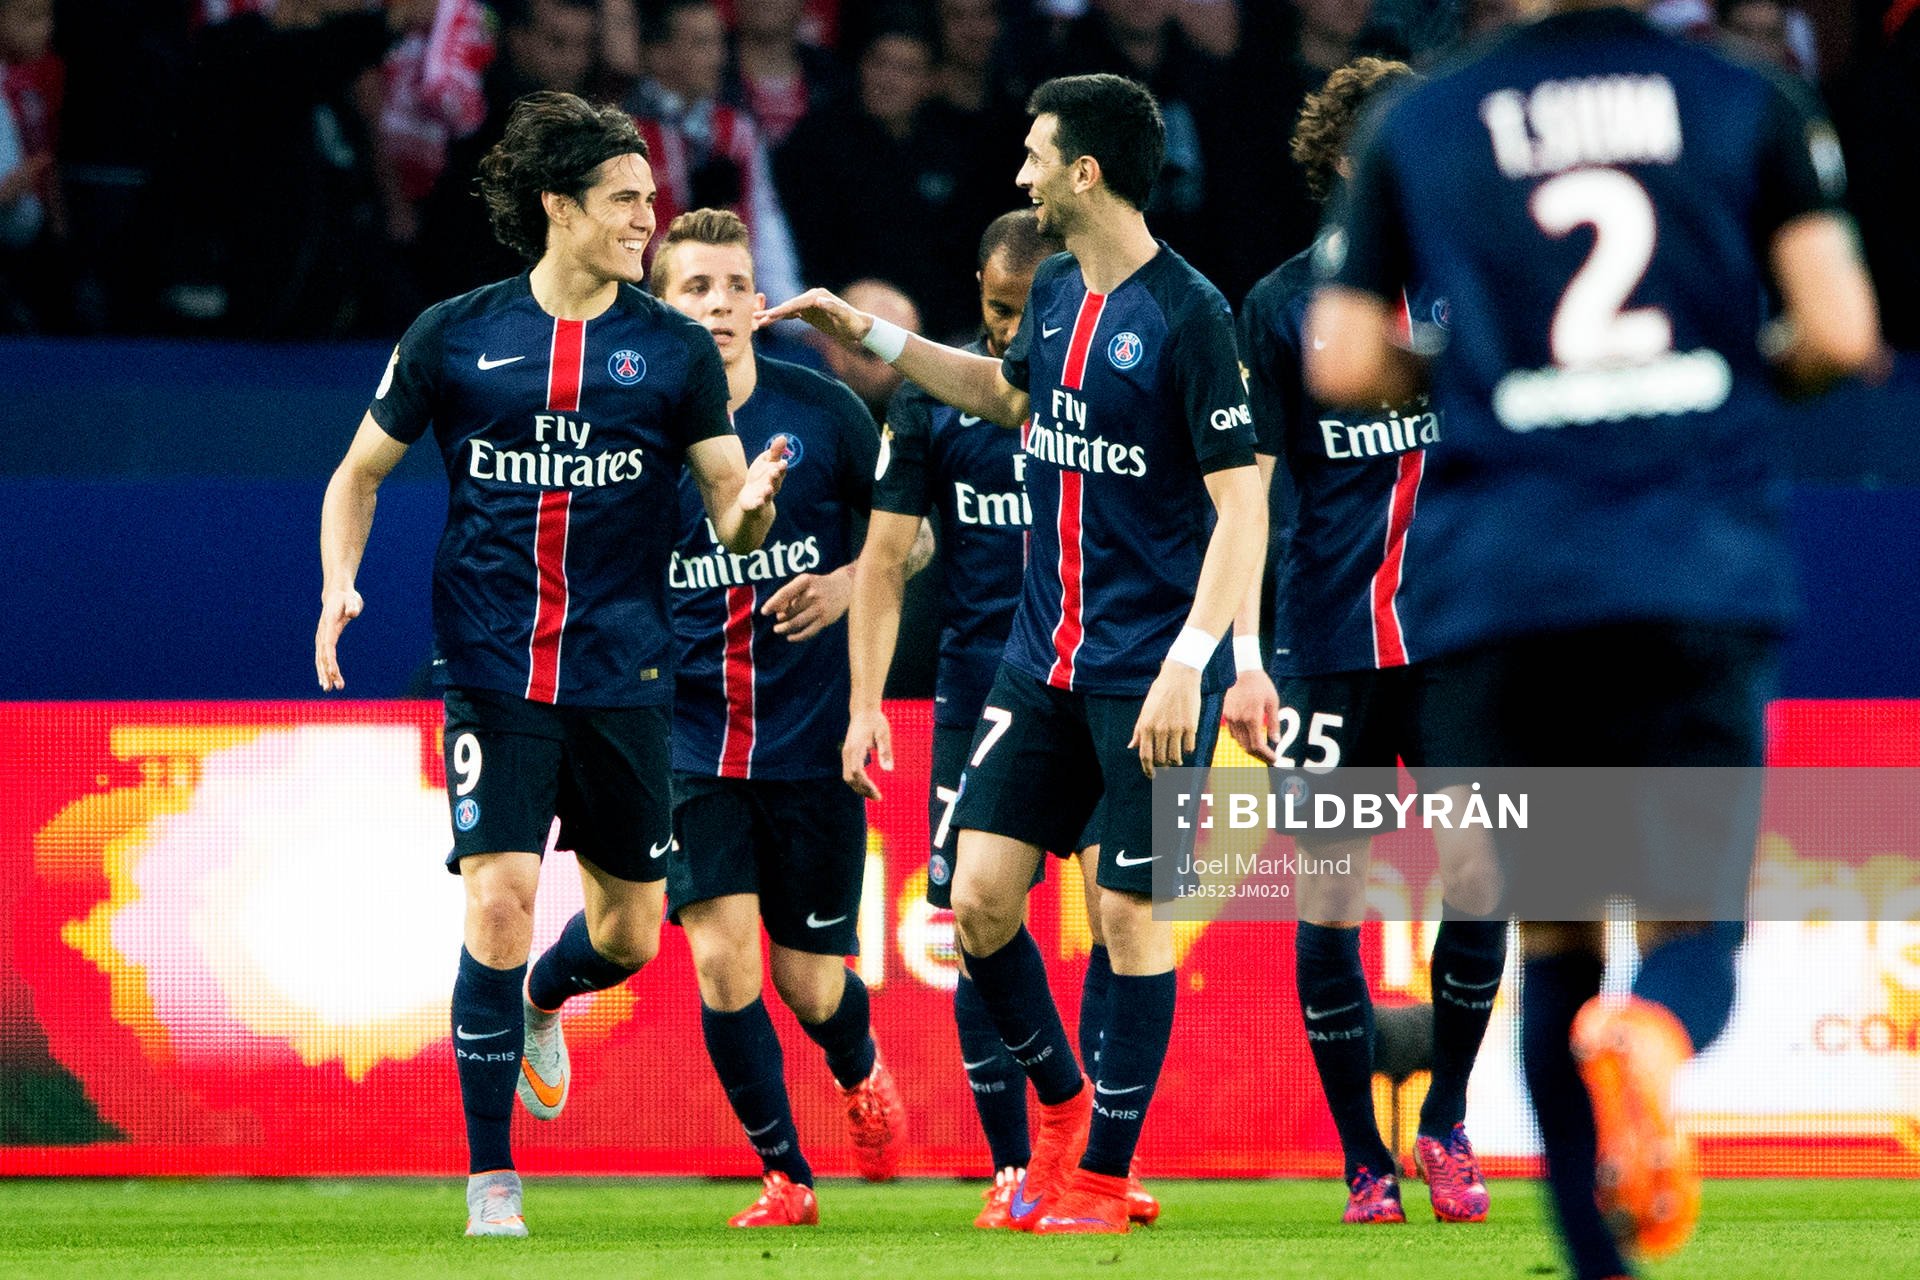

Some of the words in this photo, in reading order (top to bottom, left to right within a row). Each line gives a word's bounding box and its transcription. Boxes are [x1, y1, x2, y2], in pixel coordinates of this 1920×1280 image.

[1529, 165, 1674, 367] 2
[535, 415, 591, 449] Fly
[1052, 389, 1087, 430] Fly
[469, 439, 643, 487] Emirates
[669, 536, 820, 589] Emirates
[453, 733, 482, 796] 9
[971, 706, 1012, 768] 7
[1273, 706, 1343, 775] 25
[933, 786, 960, 849] 7
[457, 1049, 516, 1062] PARIS
